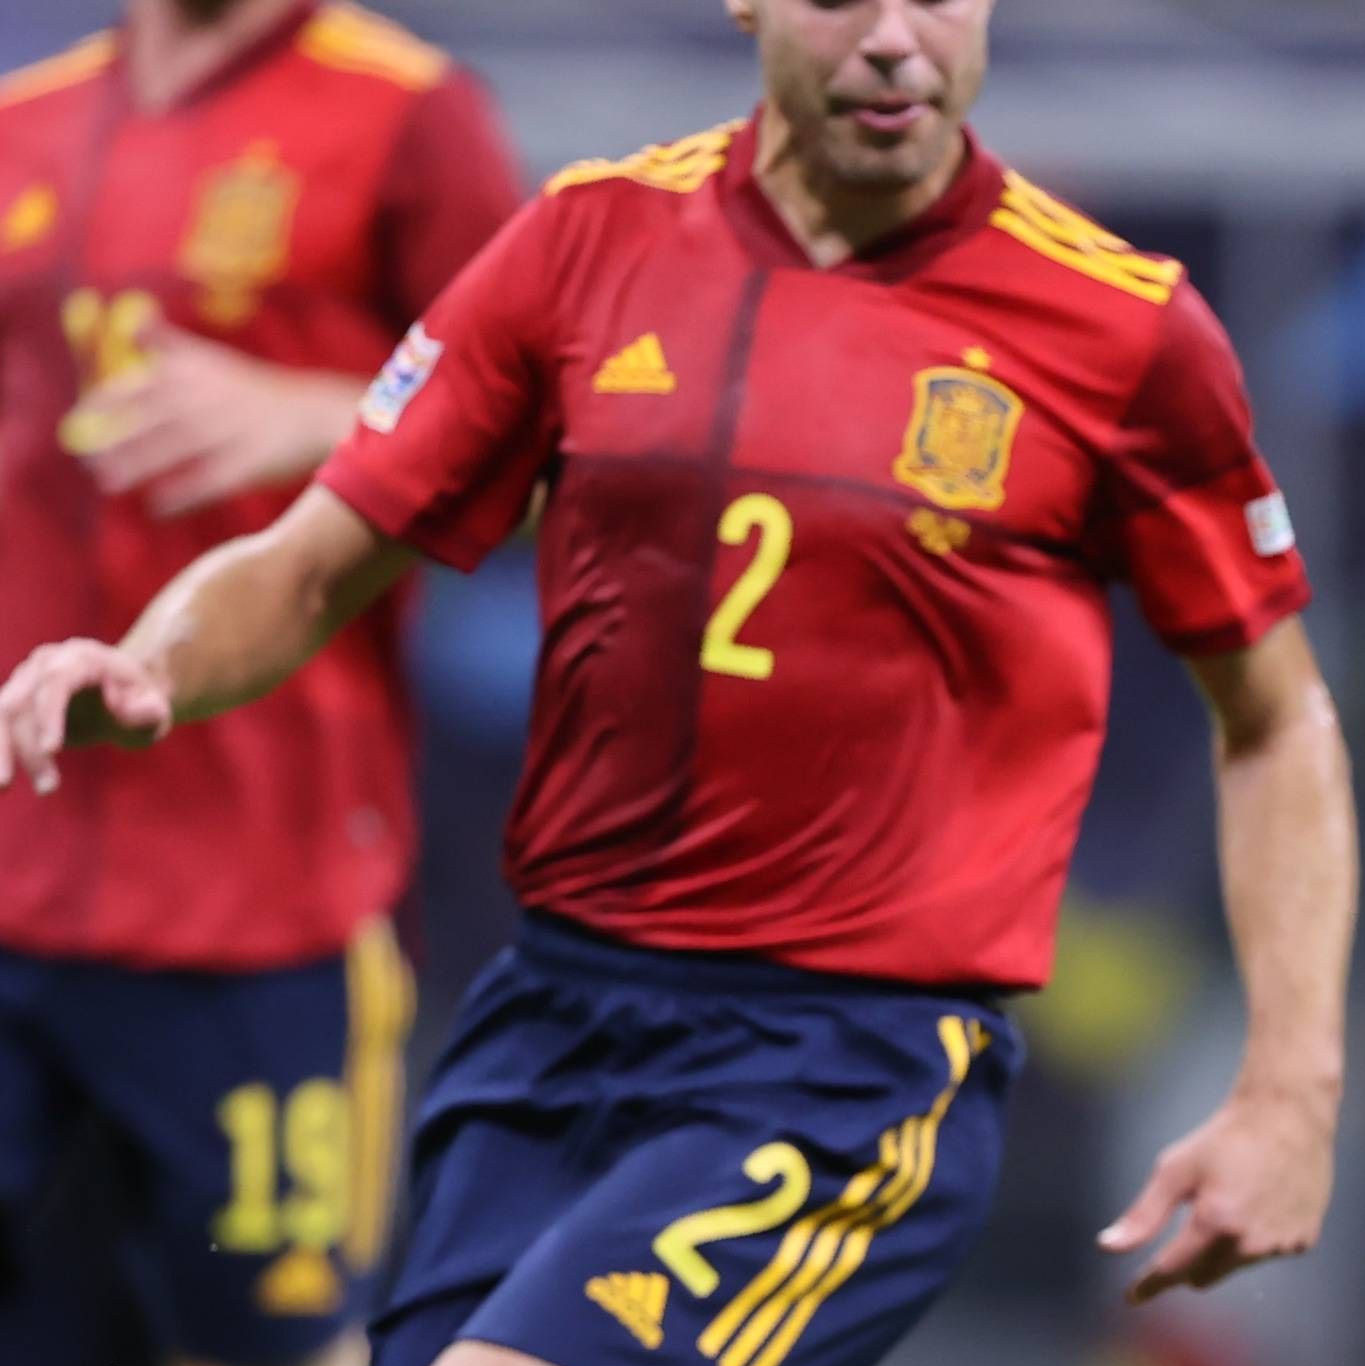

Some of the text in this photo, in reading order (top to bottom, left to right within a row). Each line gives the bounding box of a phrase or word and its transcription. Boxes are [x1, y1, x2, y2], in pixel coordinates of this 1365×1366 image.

[700, 492, 793, 680] 2
[208, 1078, 350, 1252] 19
[651, 1141, 812, 1299] 2
